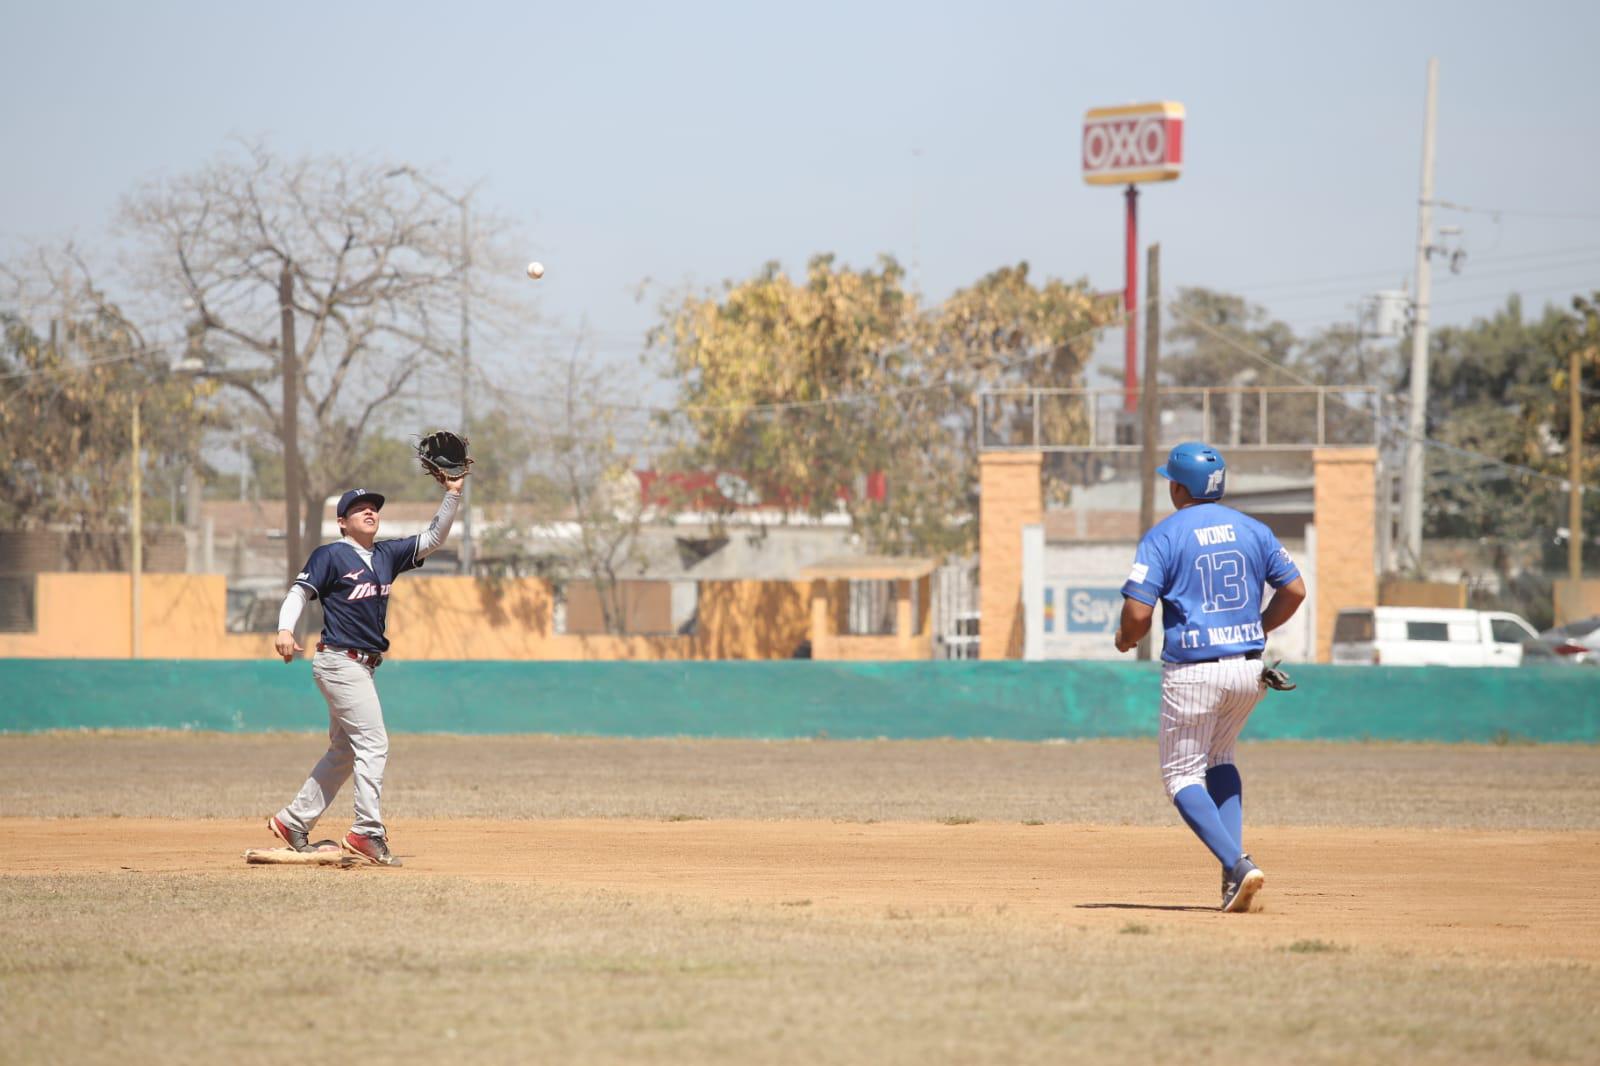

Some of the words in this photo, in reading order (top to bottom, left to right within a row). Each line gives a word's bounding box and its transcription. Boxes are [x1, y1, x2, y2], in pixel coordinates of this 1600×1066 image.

[1086, 120, 1165, 168] OXXO
[1193, 524, 1236, 546] WONG
[1195, 550, 1249, 613] 13
